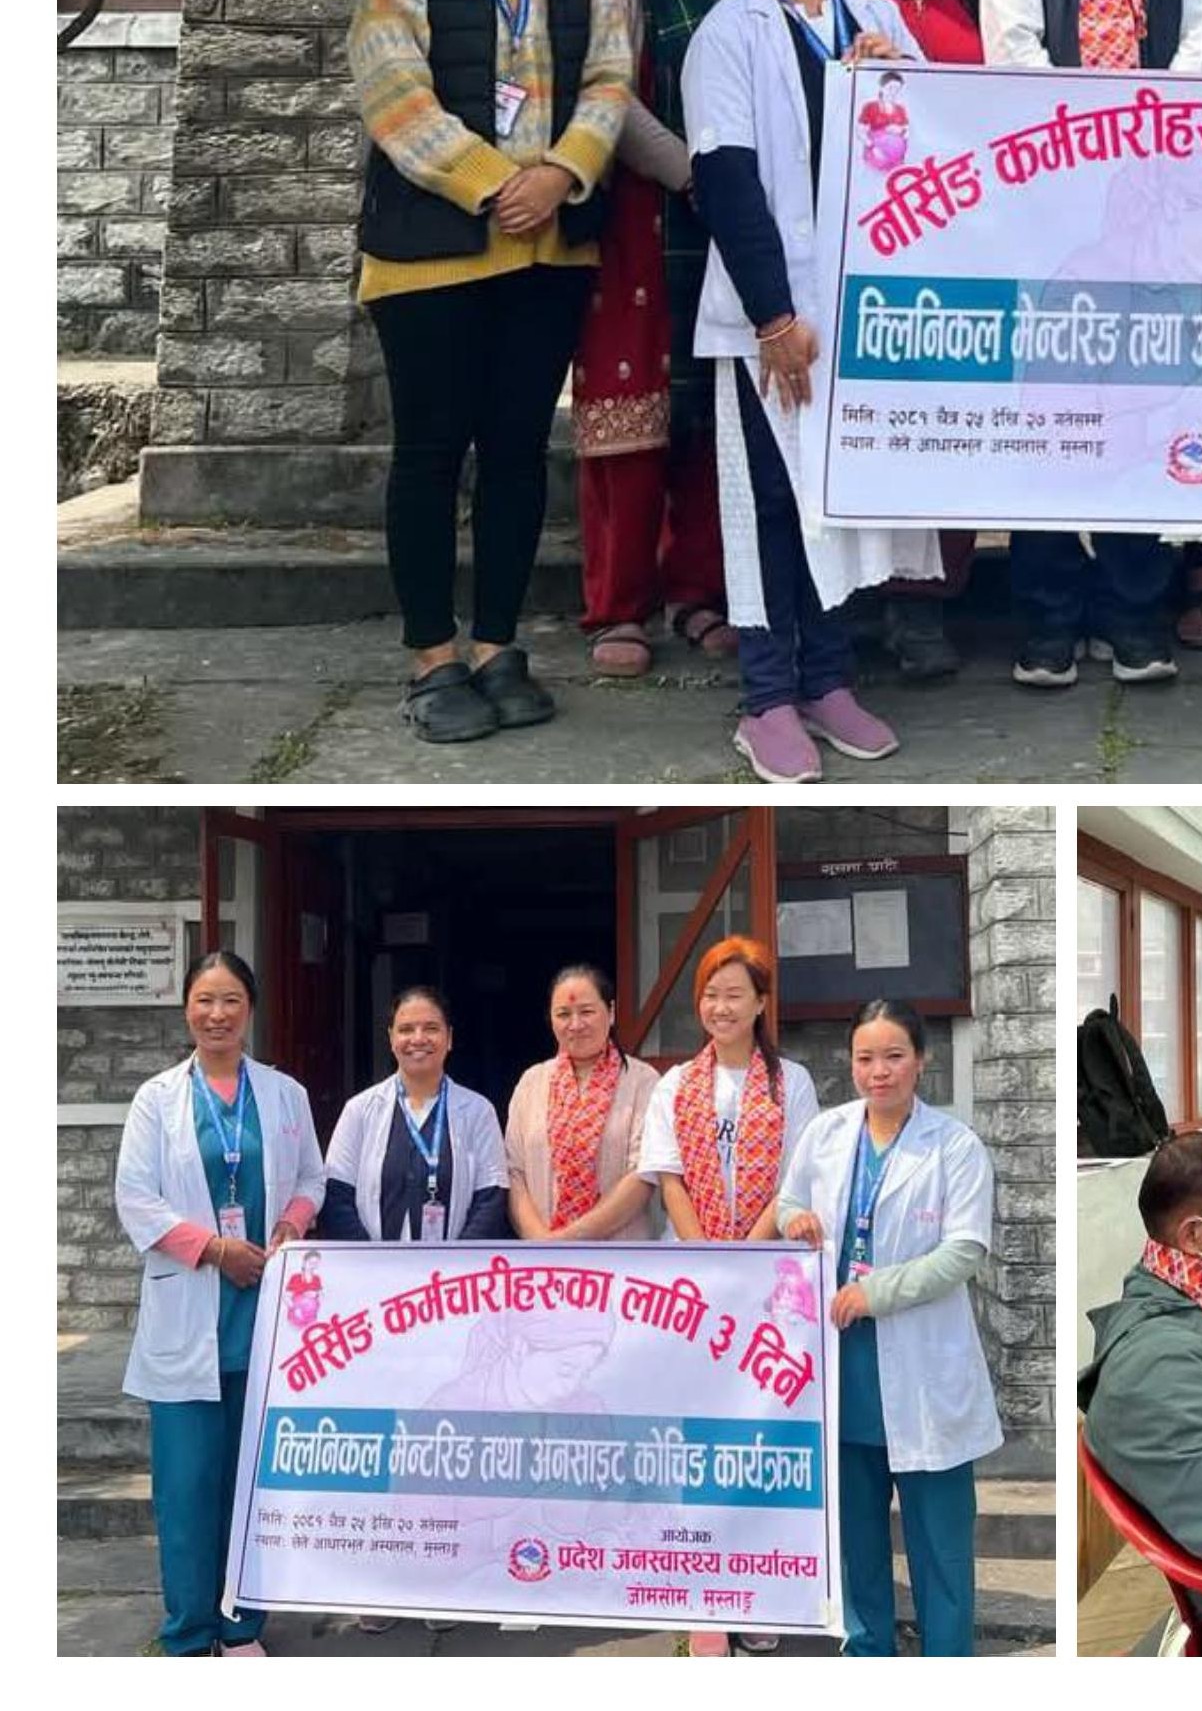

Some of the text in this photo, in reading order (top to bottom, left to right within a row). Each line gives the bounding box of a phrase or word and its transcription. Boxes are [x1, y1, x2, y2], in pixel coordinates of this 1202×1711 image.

[857, 156, 983, 256] नर्सिङ
[857, 287, 1004, 364] क्लिनिकल
[1011, 292, 1121, 366] मेन्टरिङ
[1129, 313, 1184, 366] तथा
[279, 1310, 373, 1392] नर्सिङ
[621, 1278, 709, 1342] लागि
[709, 1314, 736, 1361] ३
[739, 1323, 815, 1408] दिने
[271, 1417, 814, 1492] क्लिनिकल मेन्टरिङ तथा अनसाइट कोचिङ कार्यक्रम
[557, 1541, 818, 1578] प्रदेश जनस्वास्थ्य कार्यालय
[661, 1528, 713, 1544] आयोजक
